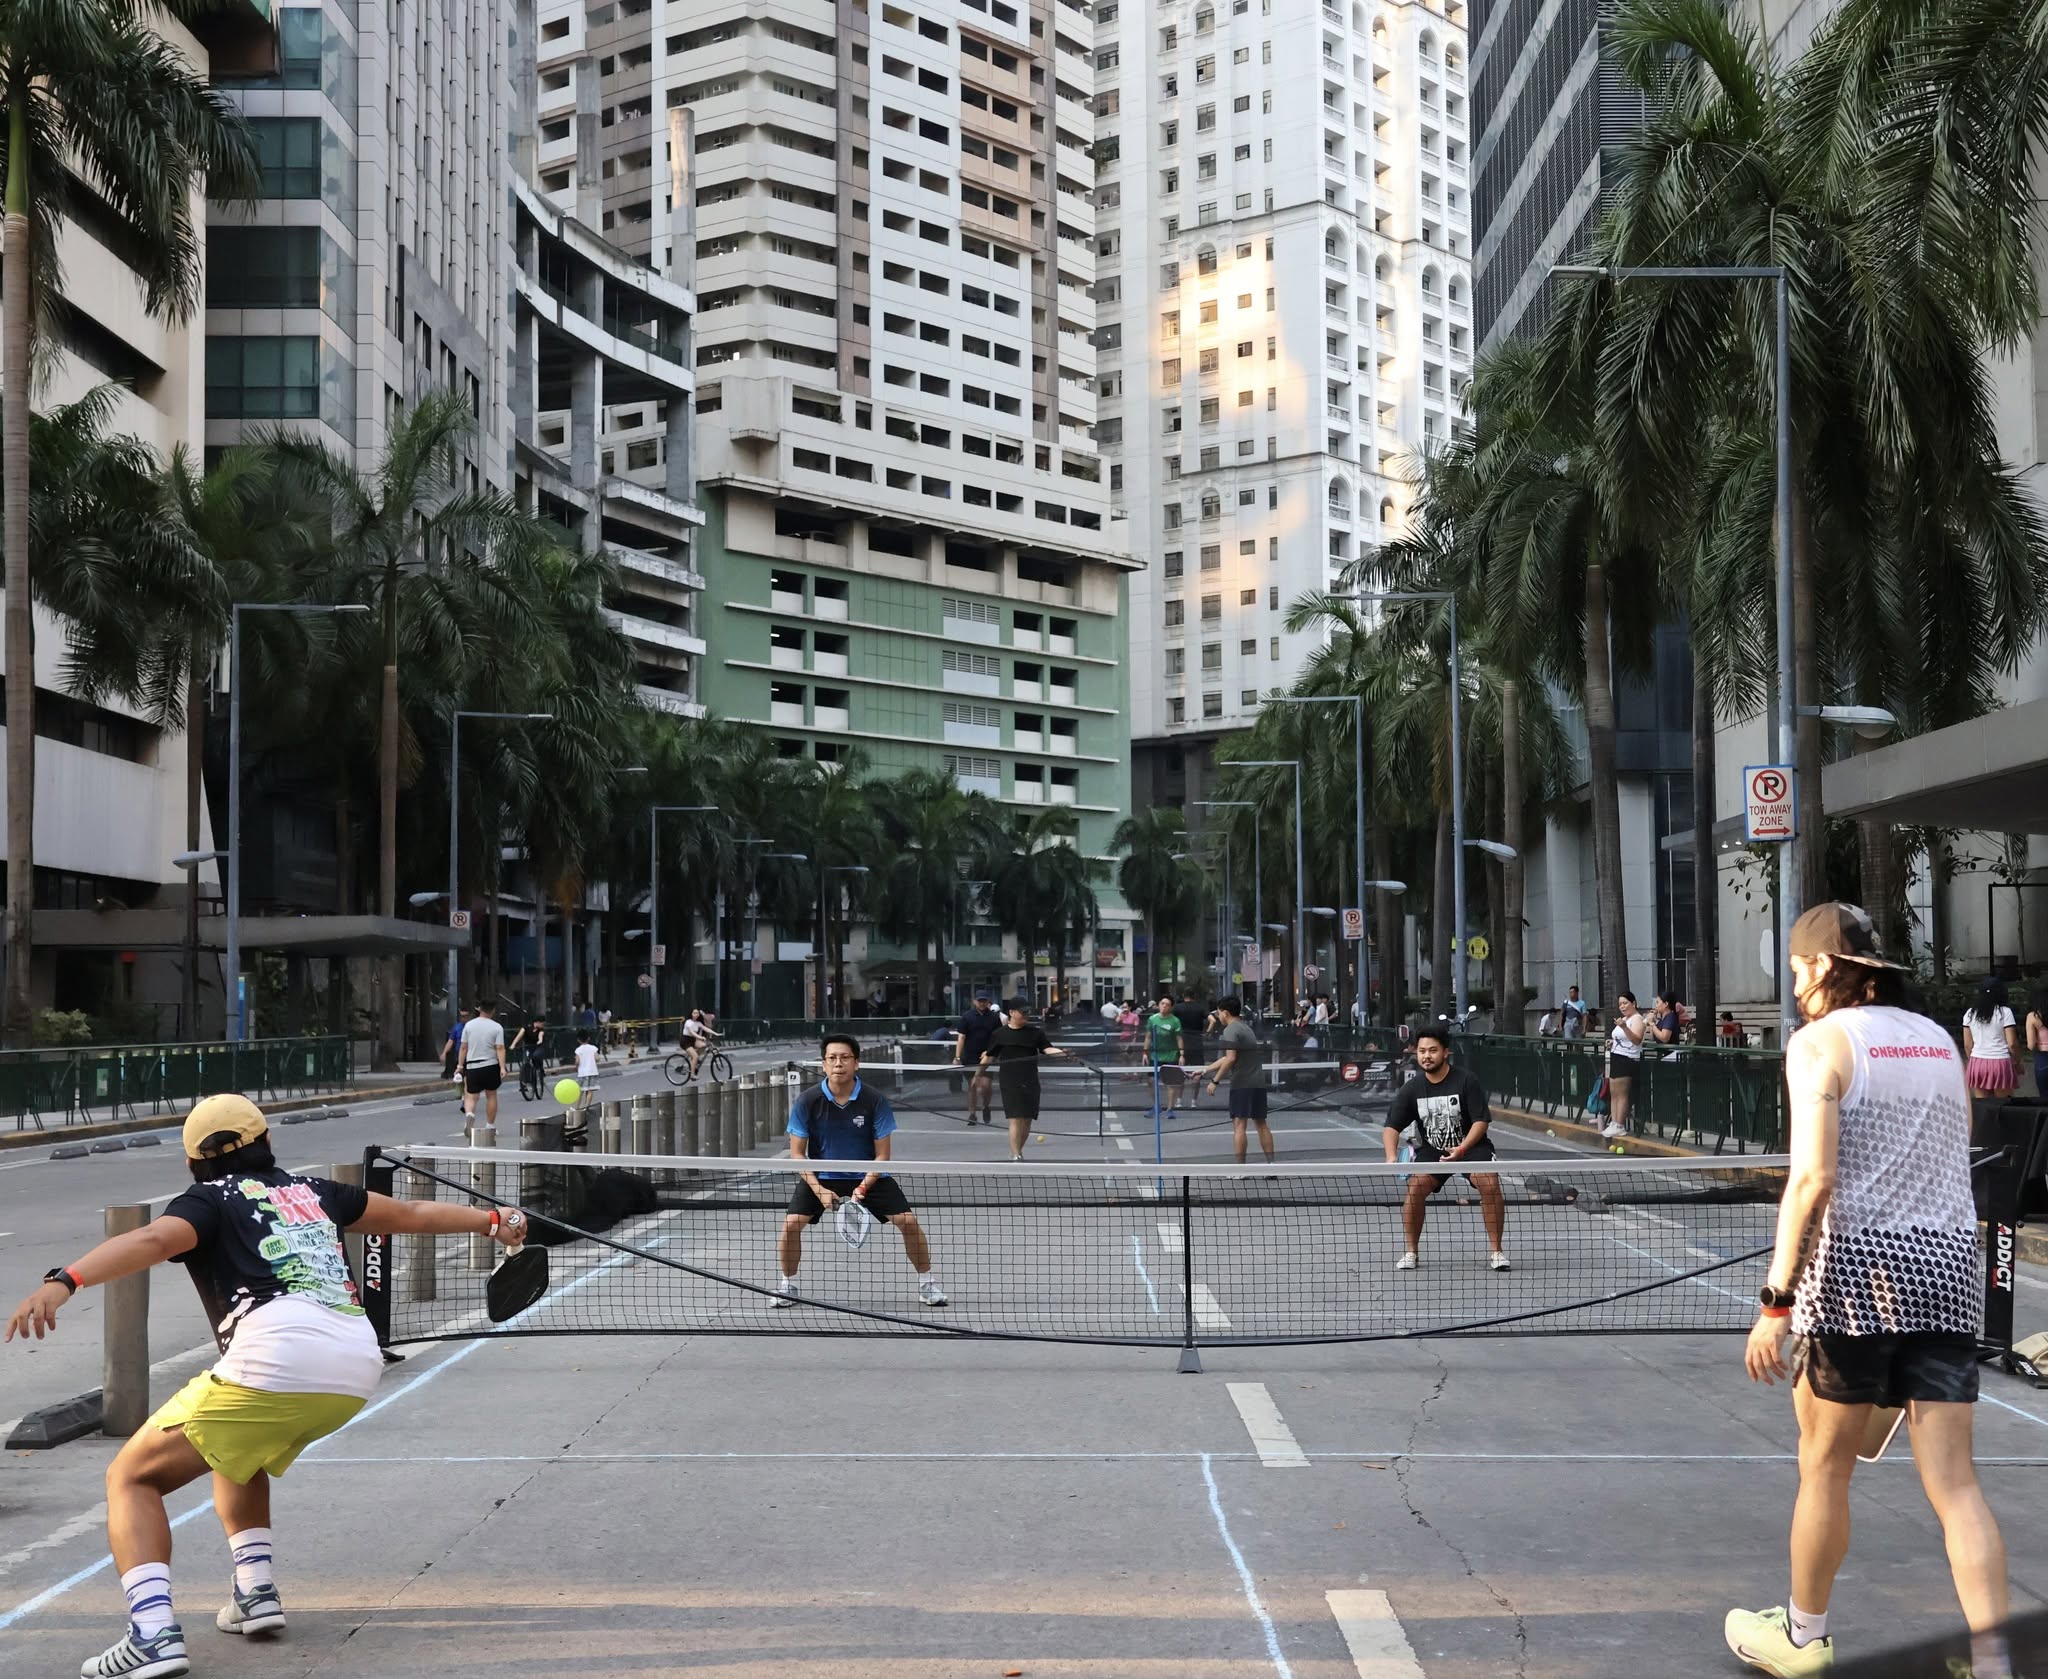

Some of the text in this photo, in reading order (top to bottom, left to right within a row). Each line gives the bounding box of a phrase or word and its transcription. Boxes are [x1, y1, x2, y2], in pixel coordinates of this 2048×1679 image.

[1749, 804, 1792, 816] TOW AWAY
[1759, 816, 1783, 826] ZONE
[1344, 1066, 1359, 1080] 2
